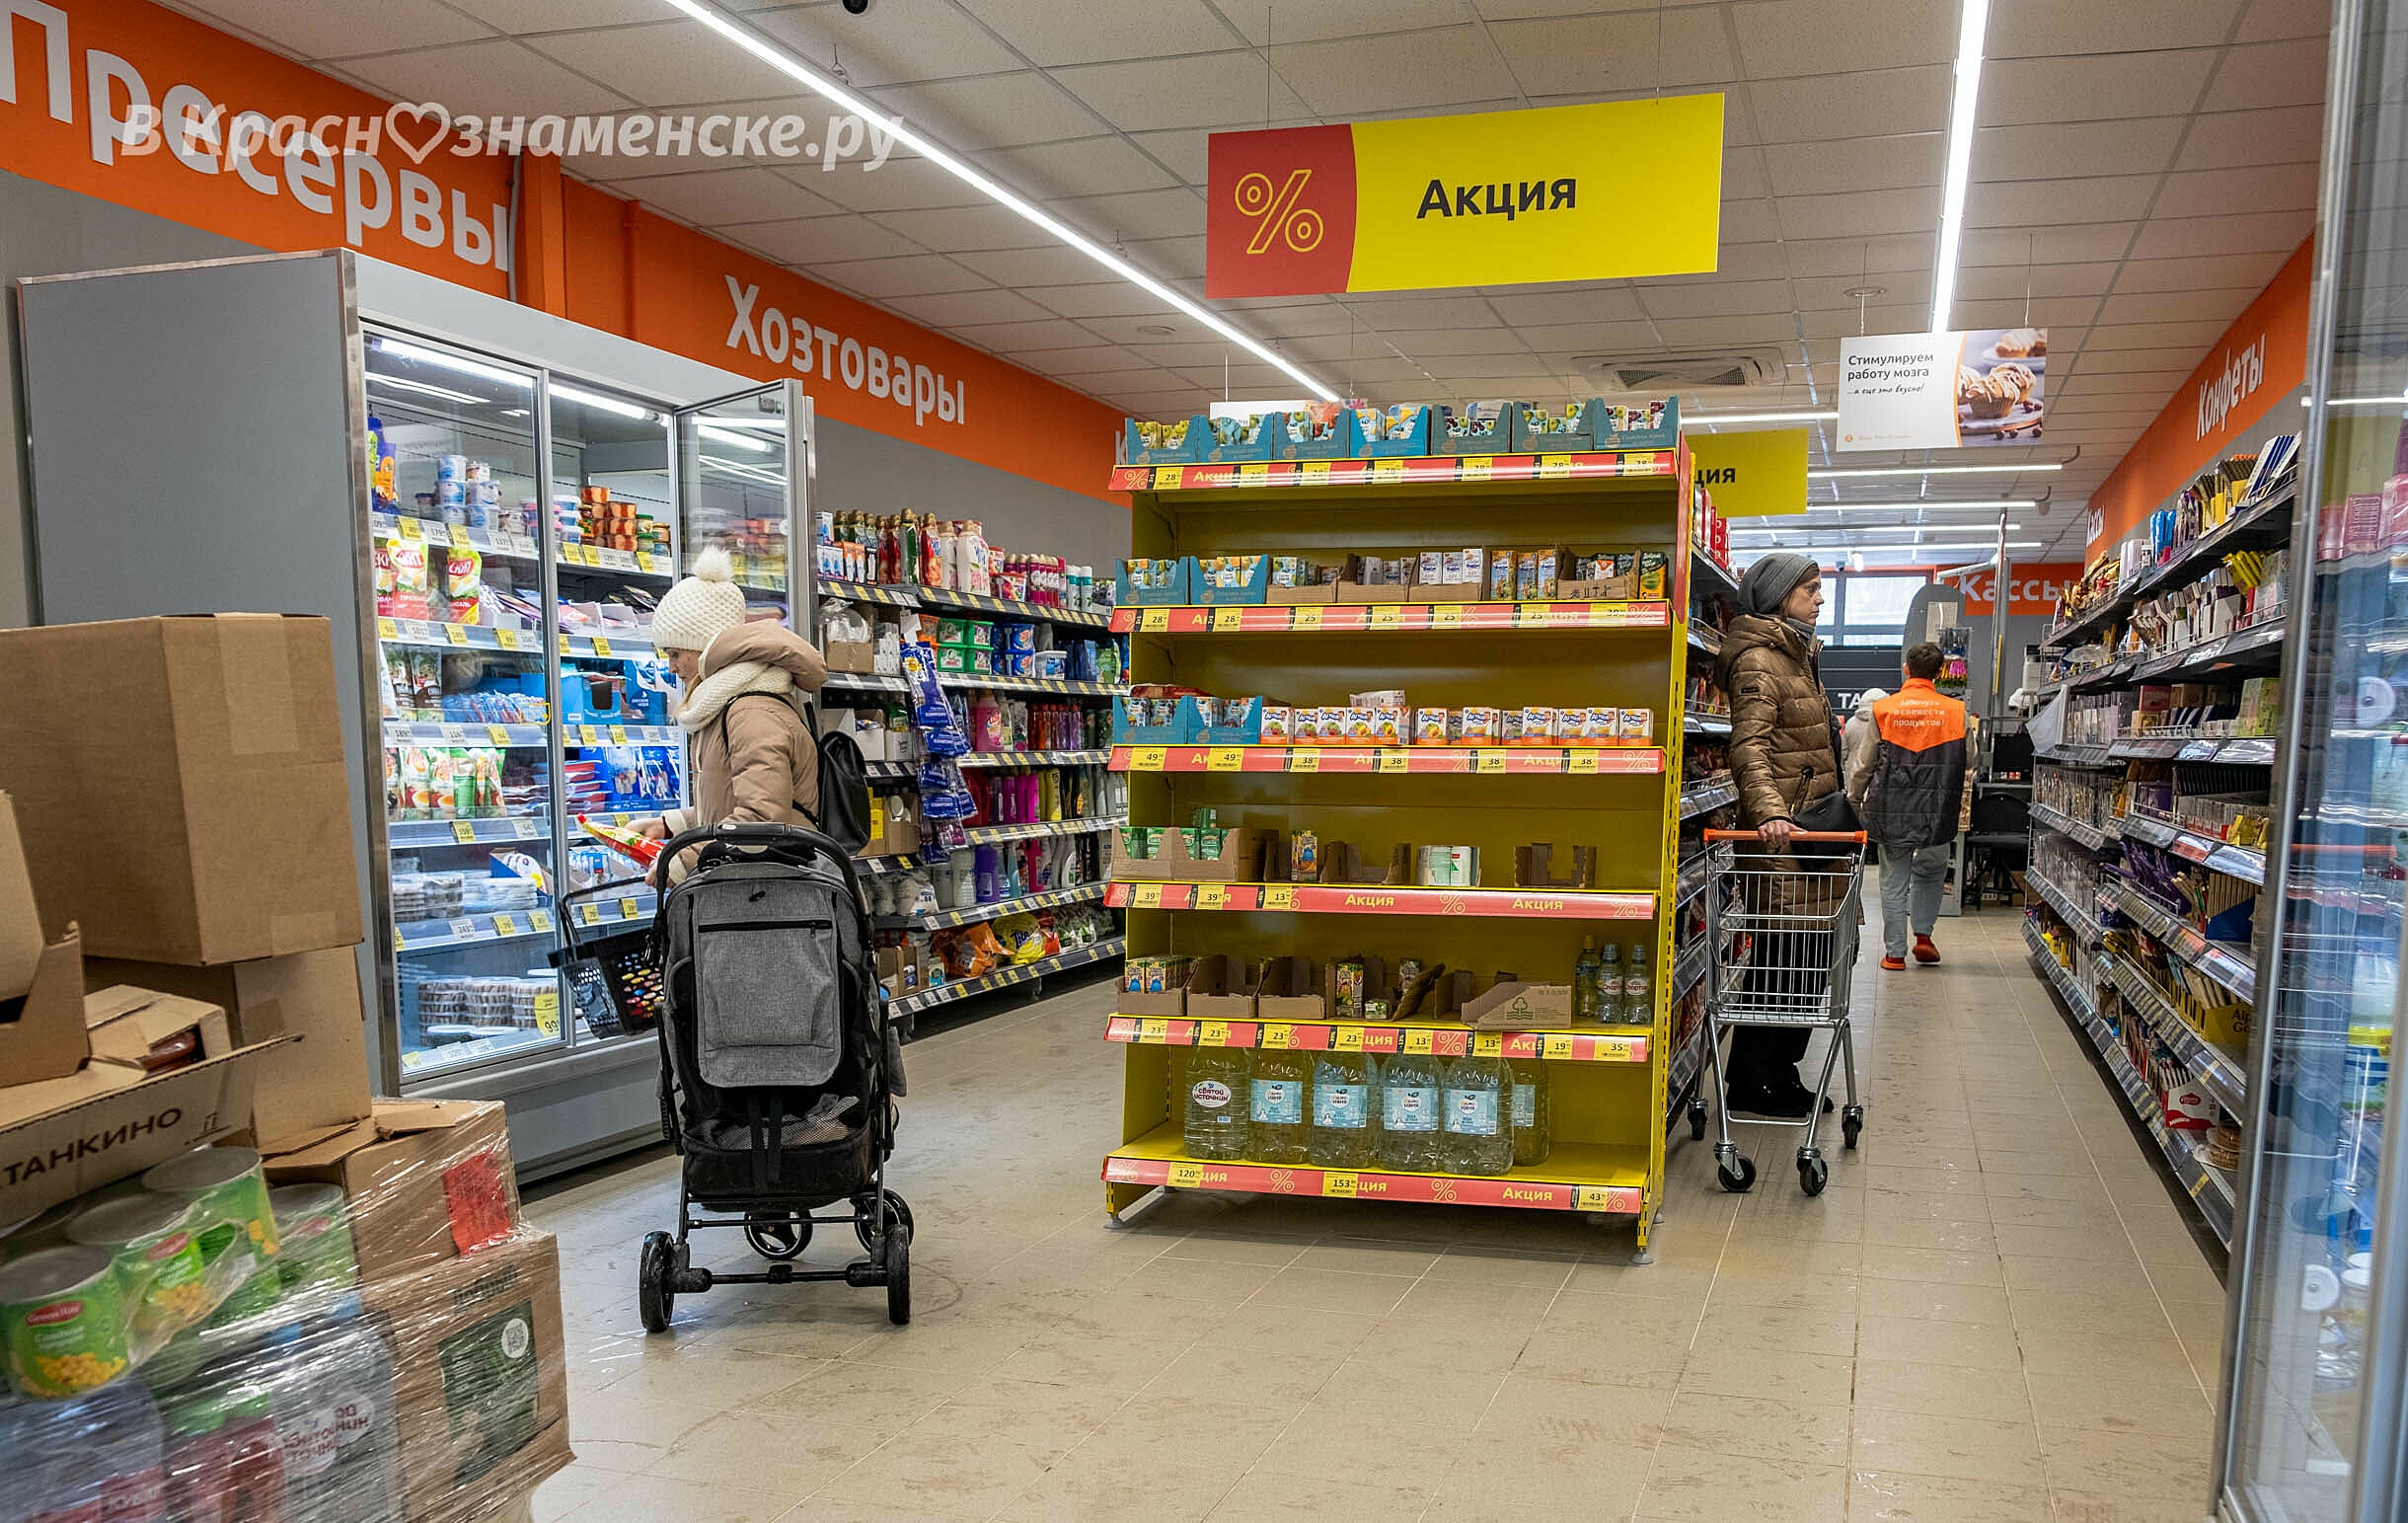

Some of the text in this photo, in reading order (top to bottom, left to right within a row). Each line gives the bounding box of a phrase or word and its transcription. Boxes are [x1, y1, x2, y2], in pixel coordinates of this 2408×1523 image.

[0, 0, 510, 272] Пресервы
[1415, 178, 1577, 221] Акция
[725, 273, 966, 425] Хозтовары
[1847, 354, 1934, 366] Стимулируем
[1847, 368, 1929, 383] работу мозга
[2196, 334, 2267, 441] Конфеты
[1693, 468, 1736, 489] ция
[1344, 893, 1394, 908] Акция
[1512, 897, 1564, 912] Акция
[2231, 1009, 2251, 1025] Alp
[1362, 1035, 1393, 1047] ция
[1, 1107, 183, 1185] ТАНКИНО
[1178, 1169, 1196, 1178] 120
[1202, 1172, 1228, 1182] ция
[1333, 1179, 1350, 1188] 153
[1356, 1180, 1387, 1192] ция
[1502, 1186, 1552, 1202] Акция
[1589, 1192, 1601, 1201] 43
